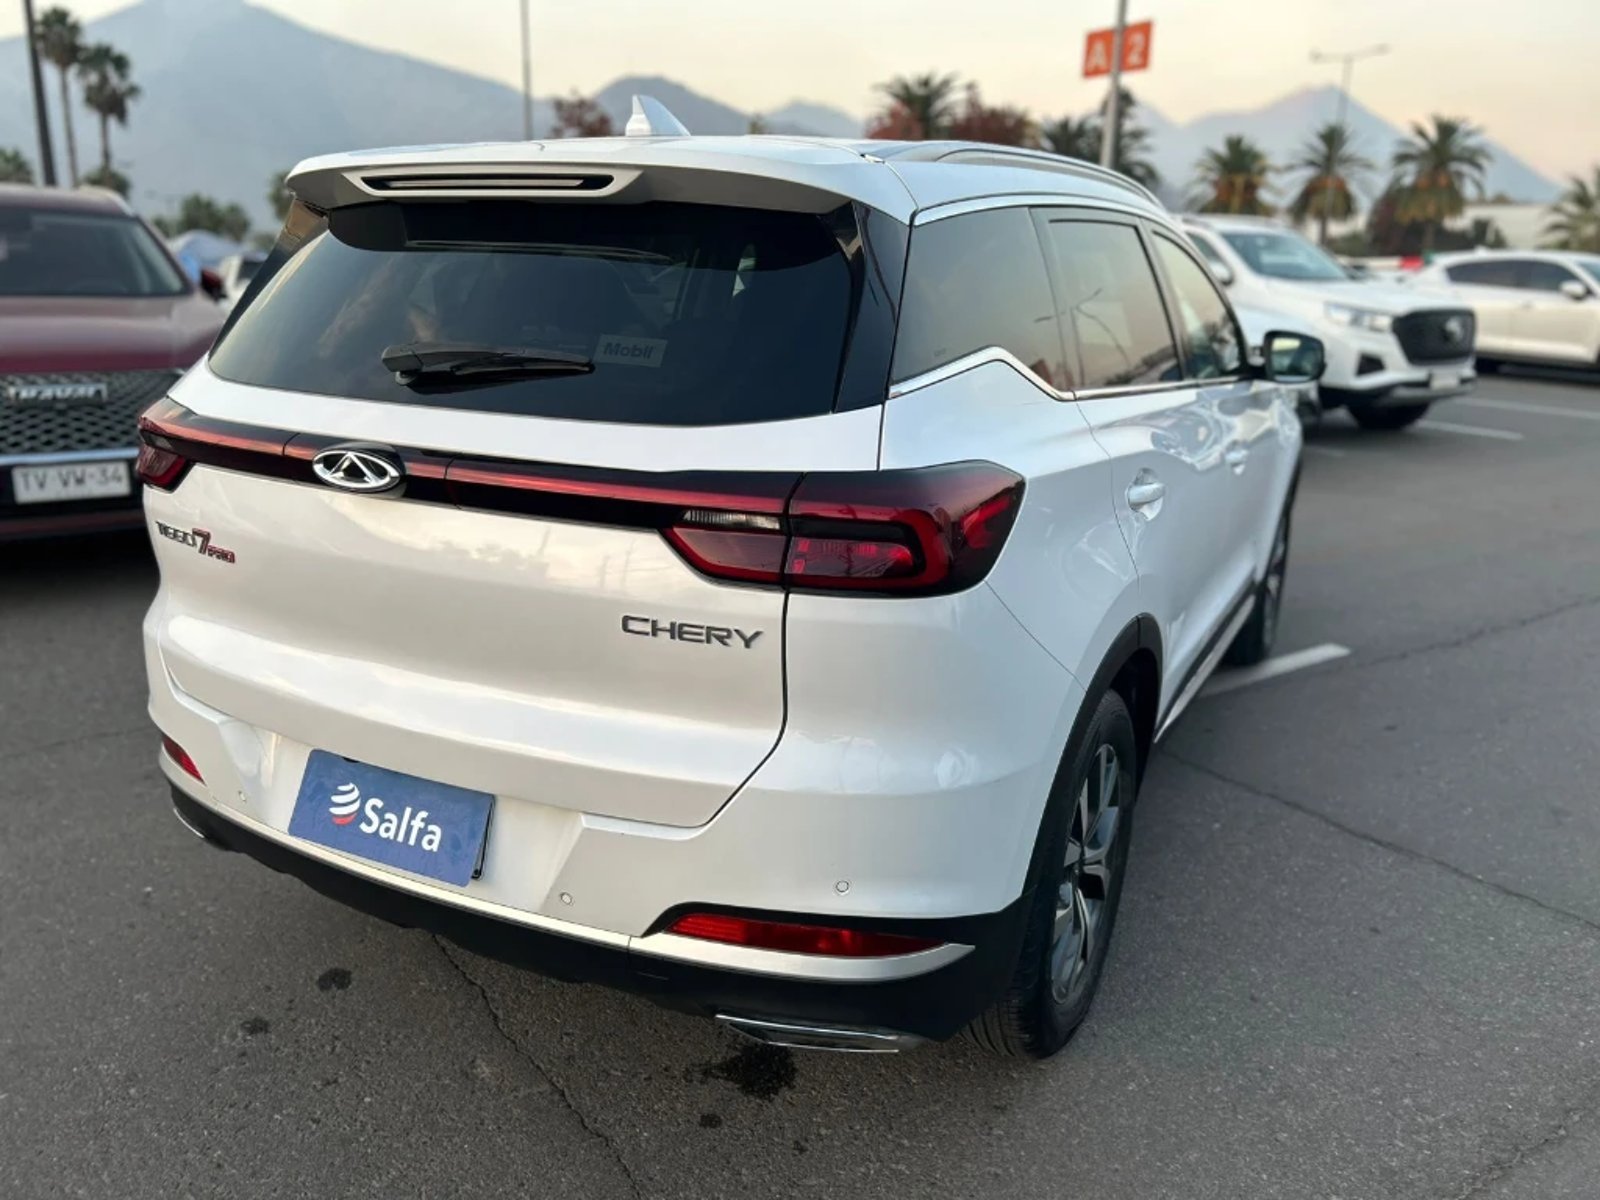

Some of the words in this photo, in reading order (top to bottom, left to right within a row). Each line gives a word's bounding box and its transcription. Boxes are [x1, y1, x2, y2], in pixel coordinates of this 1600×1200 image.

[1087, 40, 1109, 72] A
[1126, 33, 1146, 66] 2
[21, 471, 48, 491] TV
[192, 528, 211, 555] 7
[622, 615, 764, 649] CHERY
[360, 797, 442, 852] Salfa
